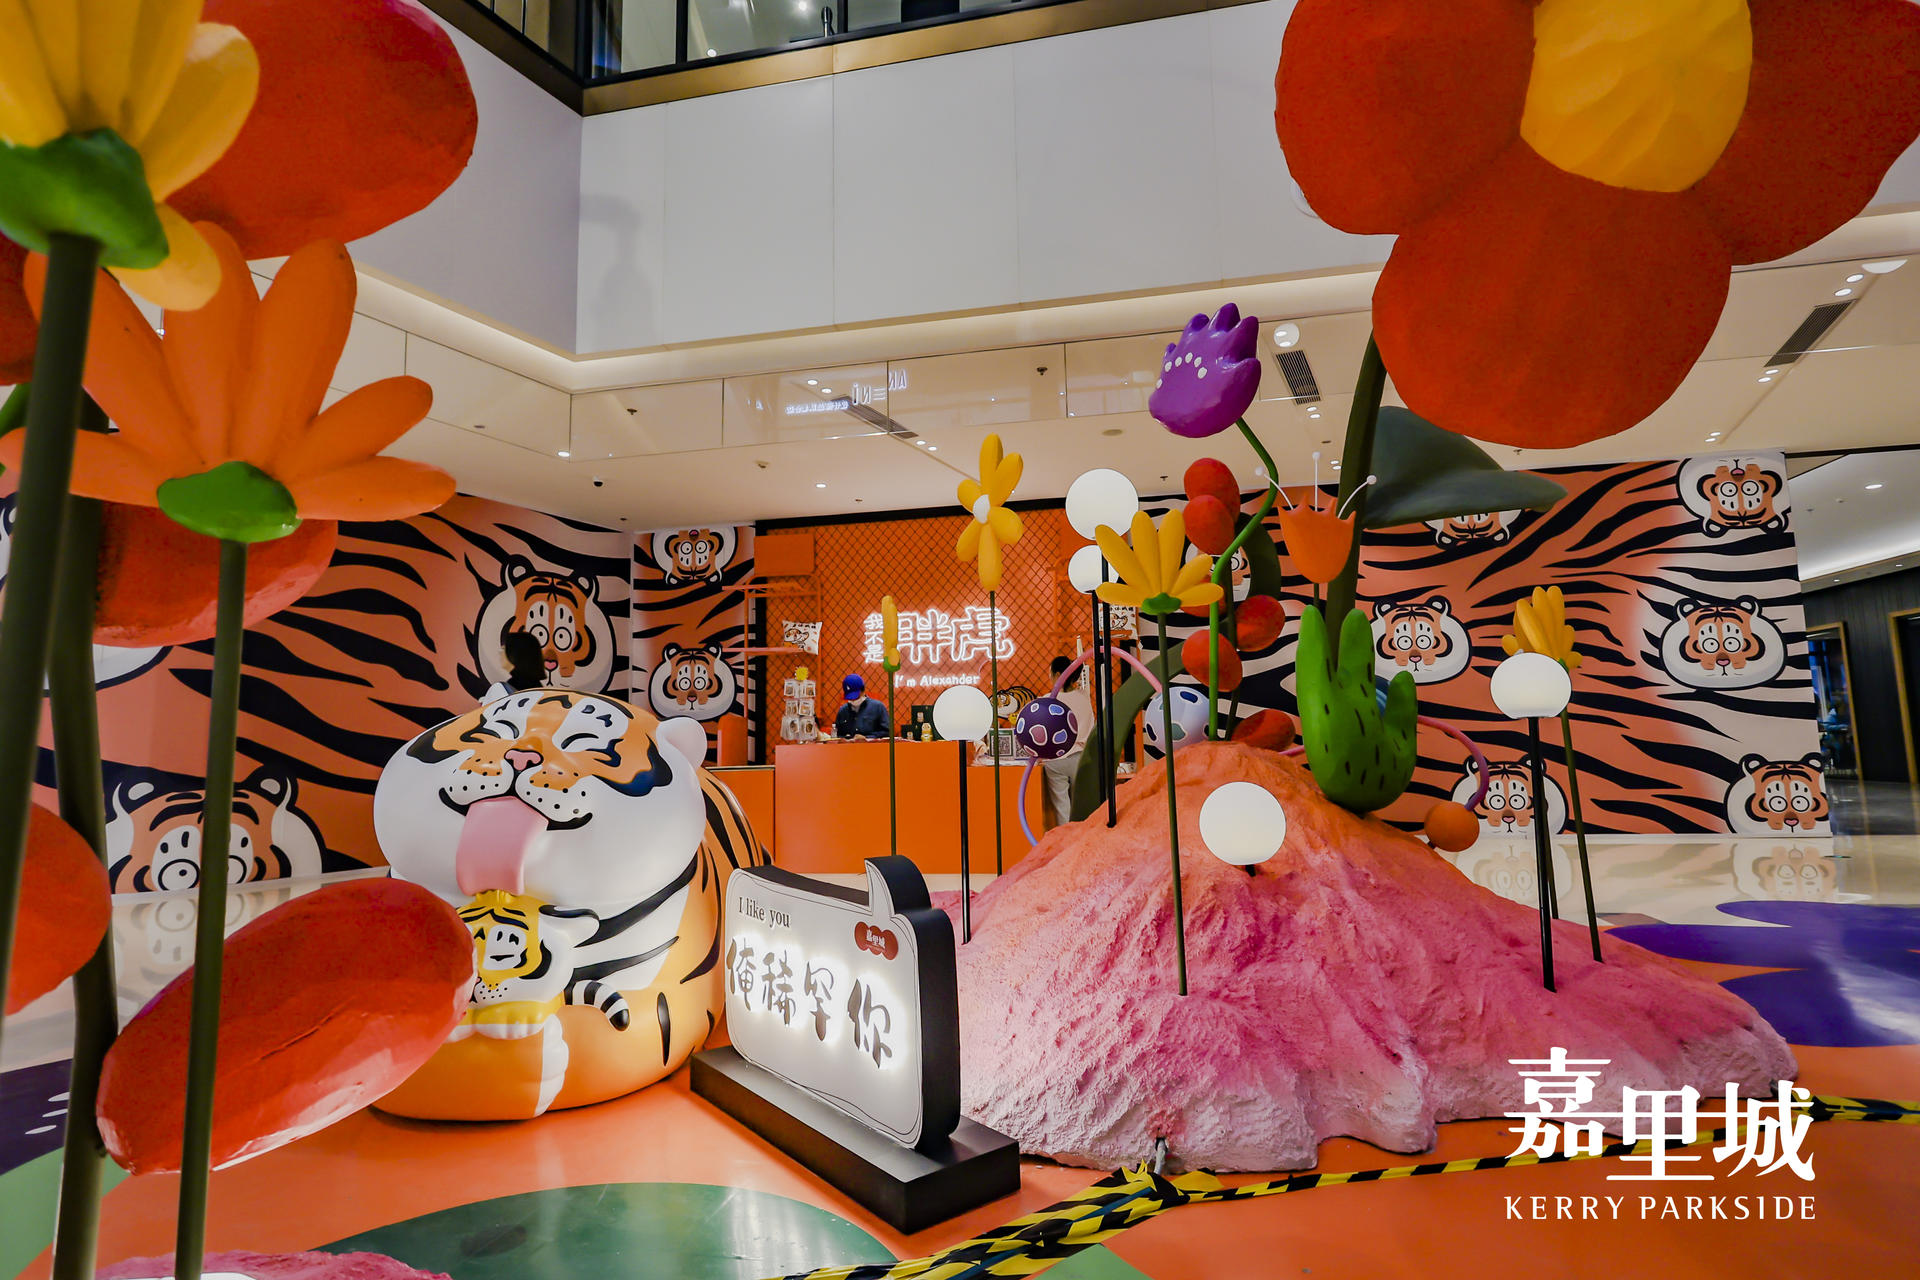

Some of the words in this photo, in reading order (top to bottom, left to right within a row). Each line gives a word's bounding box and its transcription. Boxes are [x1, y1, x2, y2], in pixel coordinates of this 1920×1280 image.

[919, 673, 980, 686] Alexander
[739, 897, 743, 913] I
[746, 898, 765, 921] like
[769, 909, 790, 928] you
[726, 937, 892, 1069] 俺稀罕你
